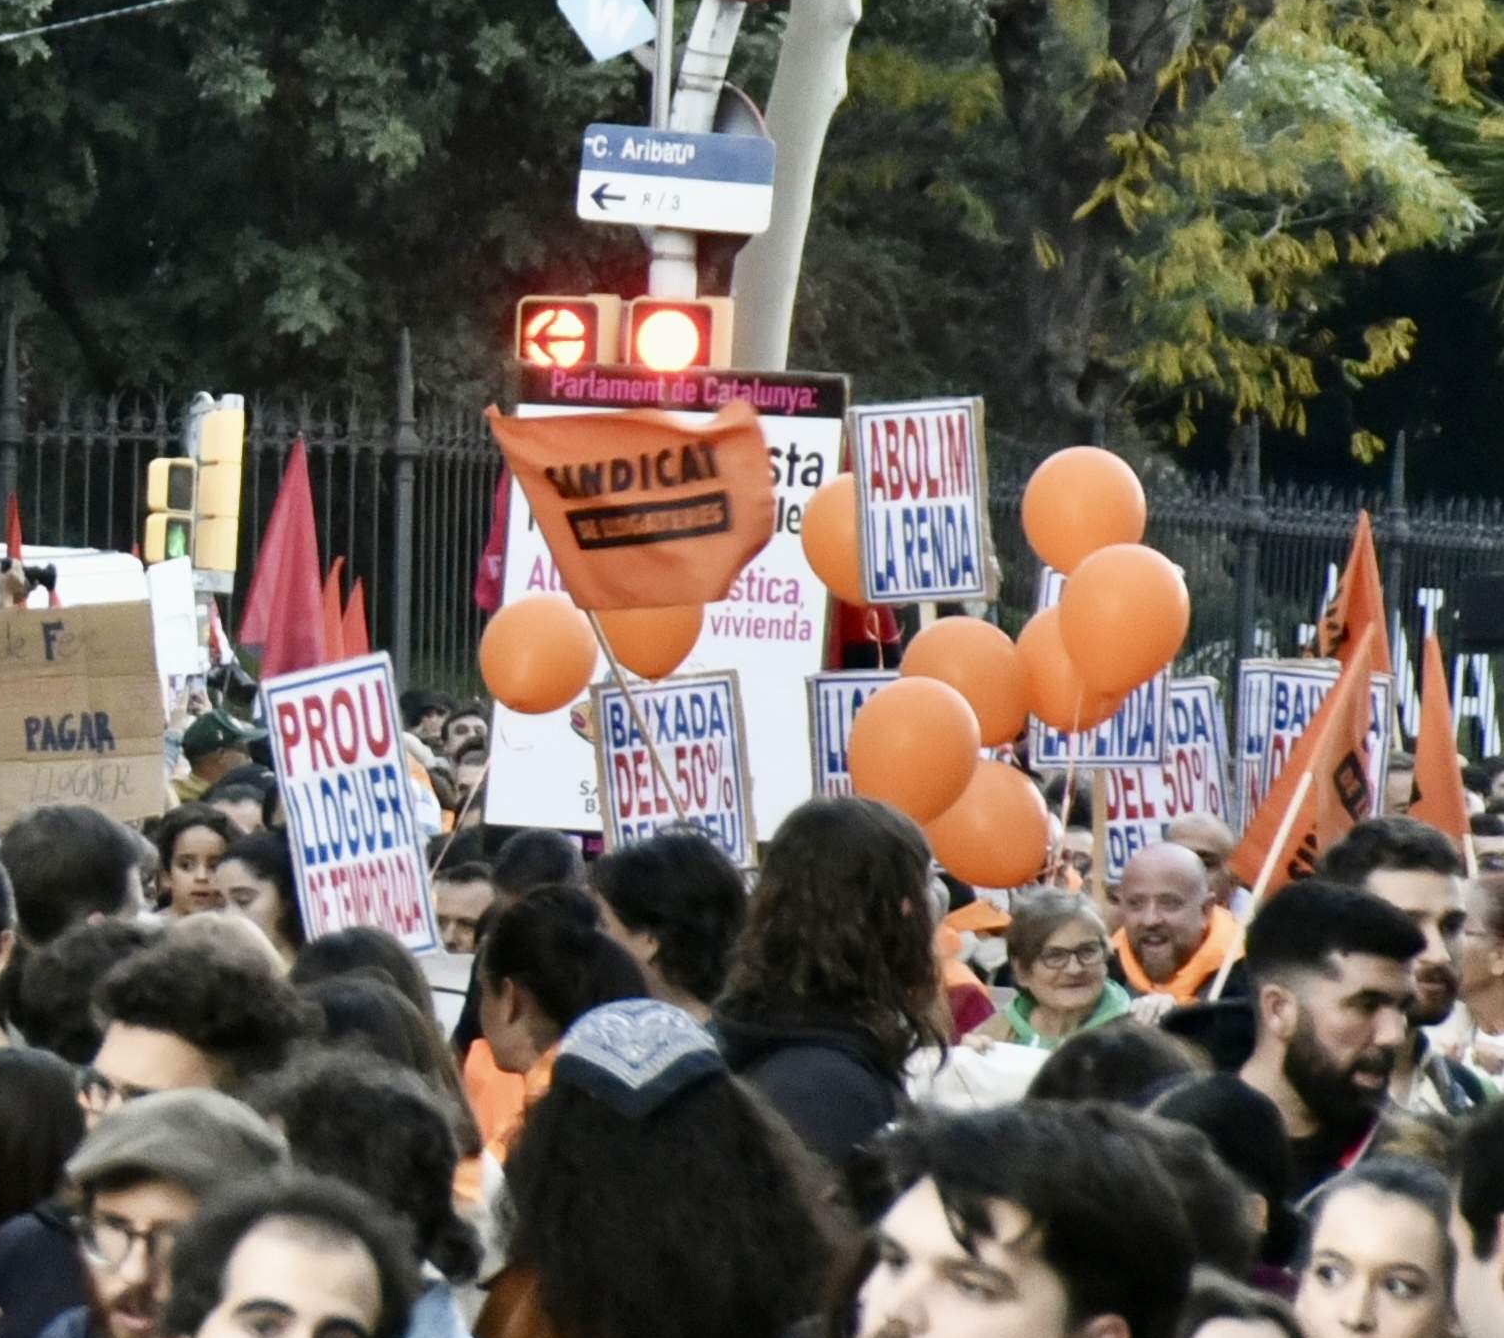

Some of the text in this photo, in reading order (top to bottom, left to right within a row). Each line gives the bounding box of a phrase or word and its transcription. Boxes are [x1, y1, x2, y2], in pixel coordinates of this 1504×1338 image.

[550, 368, 819, 414] Parlament de Catalunya:
[870, 413, 970, 503] ABOLIM
[870, 503, 977, 593] LA RENDA
[710, 606, 813, 642] vivienda
[23, 710, 116, 755] PAGAR
[276, 680, 391, 778] PROU
[609, 691, 727, 749] BAIXADA
[288, 762, 410, 868] LLOGUER
[614, 749, 669, 819] DEL
[674, 740, 734, 813] 50%
